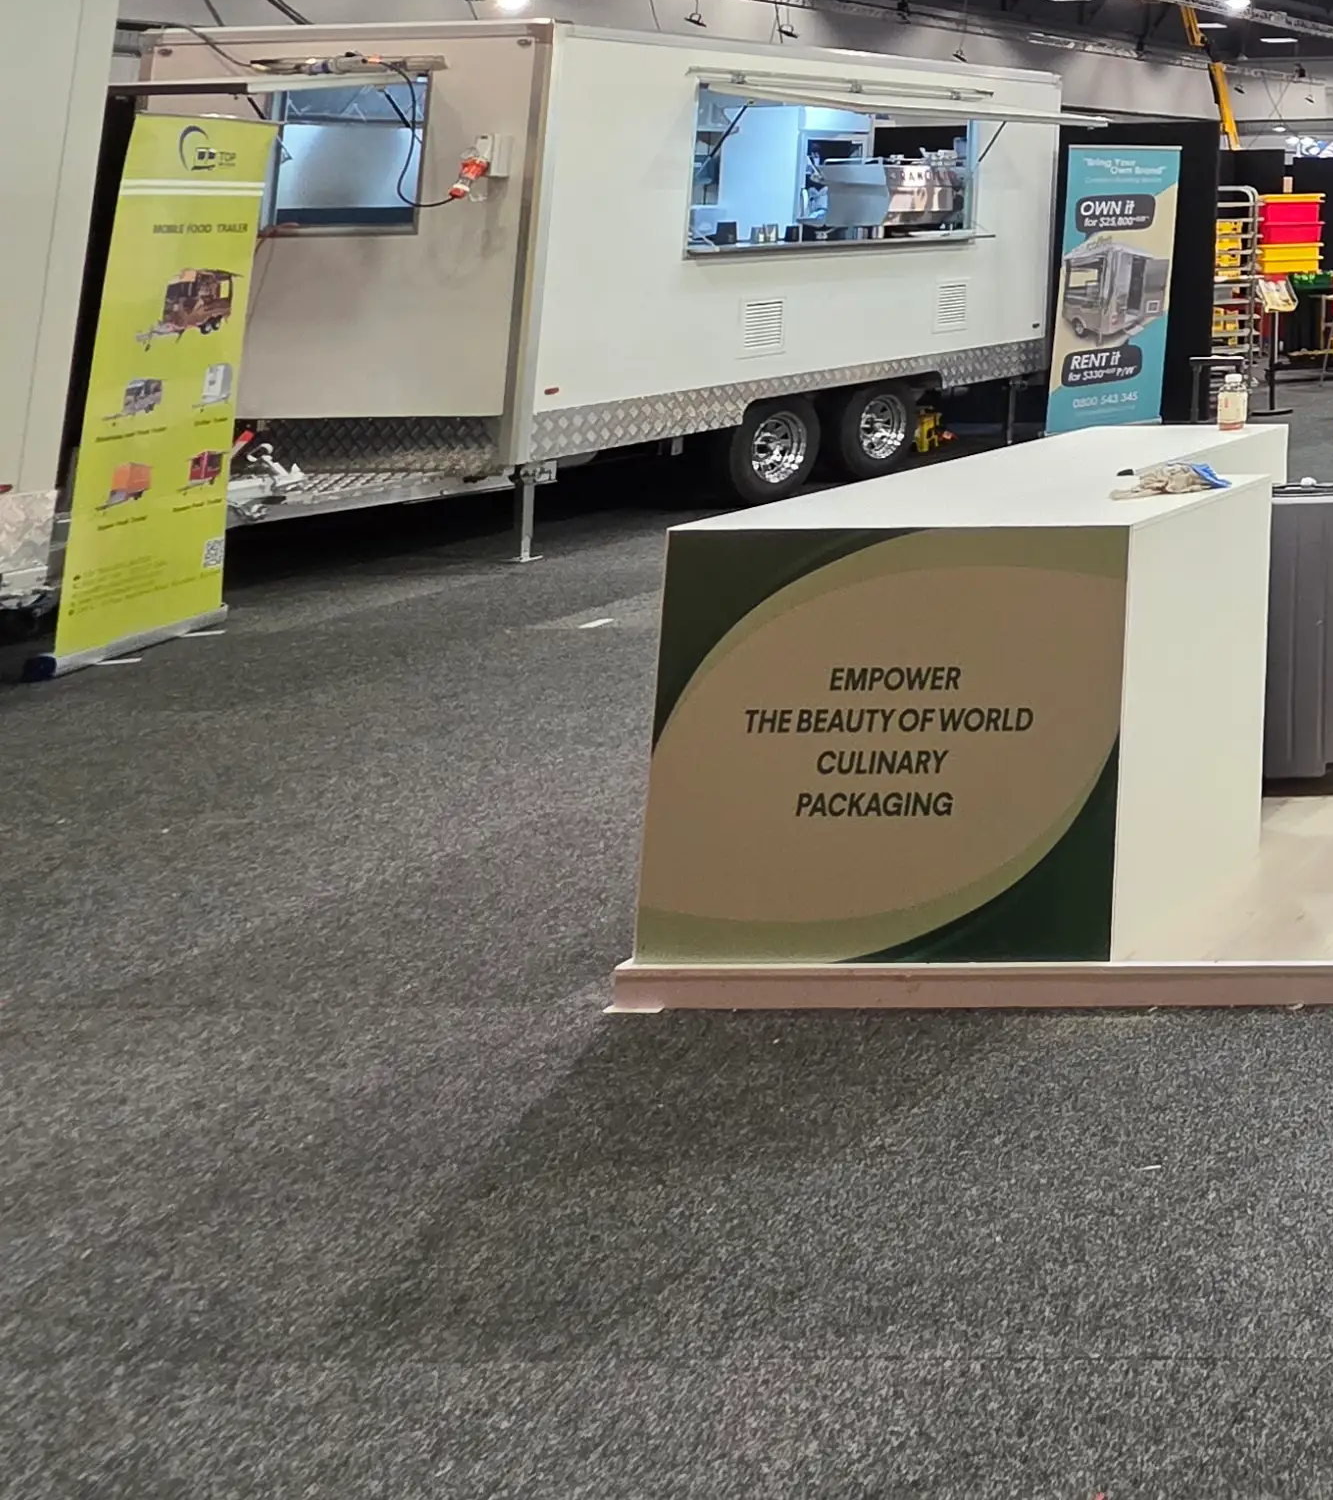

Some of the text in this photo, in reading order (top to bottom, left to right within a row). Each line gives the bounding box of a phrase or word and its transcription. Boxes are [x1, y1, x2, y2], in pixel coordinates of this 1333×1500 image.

[1080, 200, 1135, 216] OWN it
[153, 223, 248, 233] MOBILE FOOD TRAILER
[1084, 217, 1097, 227] for
[1070, 351, 1121, 370] RENT it
[1068, 372, 1082, 382] for
[1073, 391, 1138, 408] 0800 543 345
[829, 666, 961, 691] EMPOWER
[745, 707, 1034, 734] THE BEAUTY OF WORLD
[816, 750, 949, 775] CULINARY
[795, 792, 954, 817] PACKAGING
